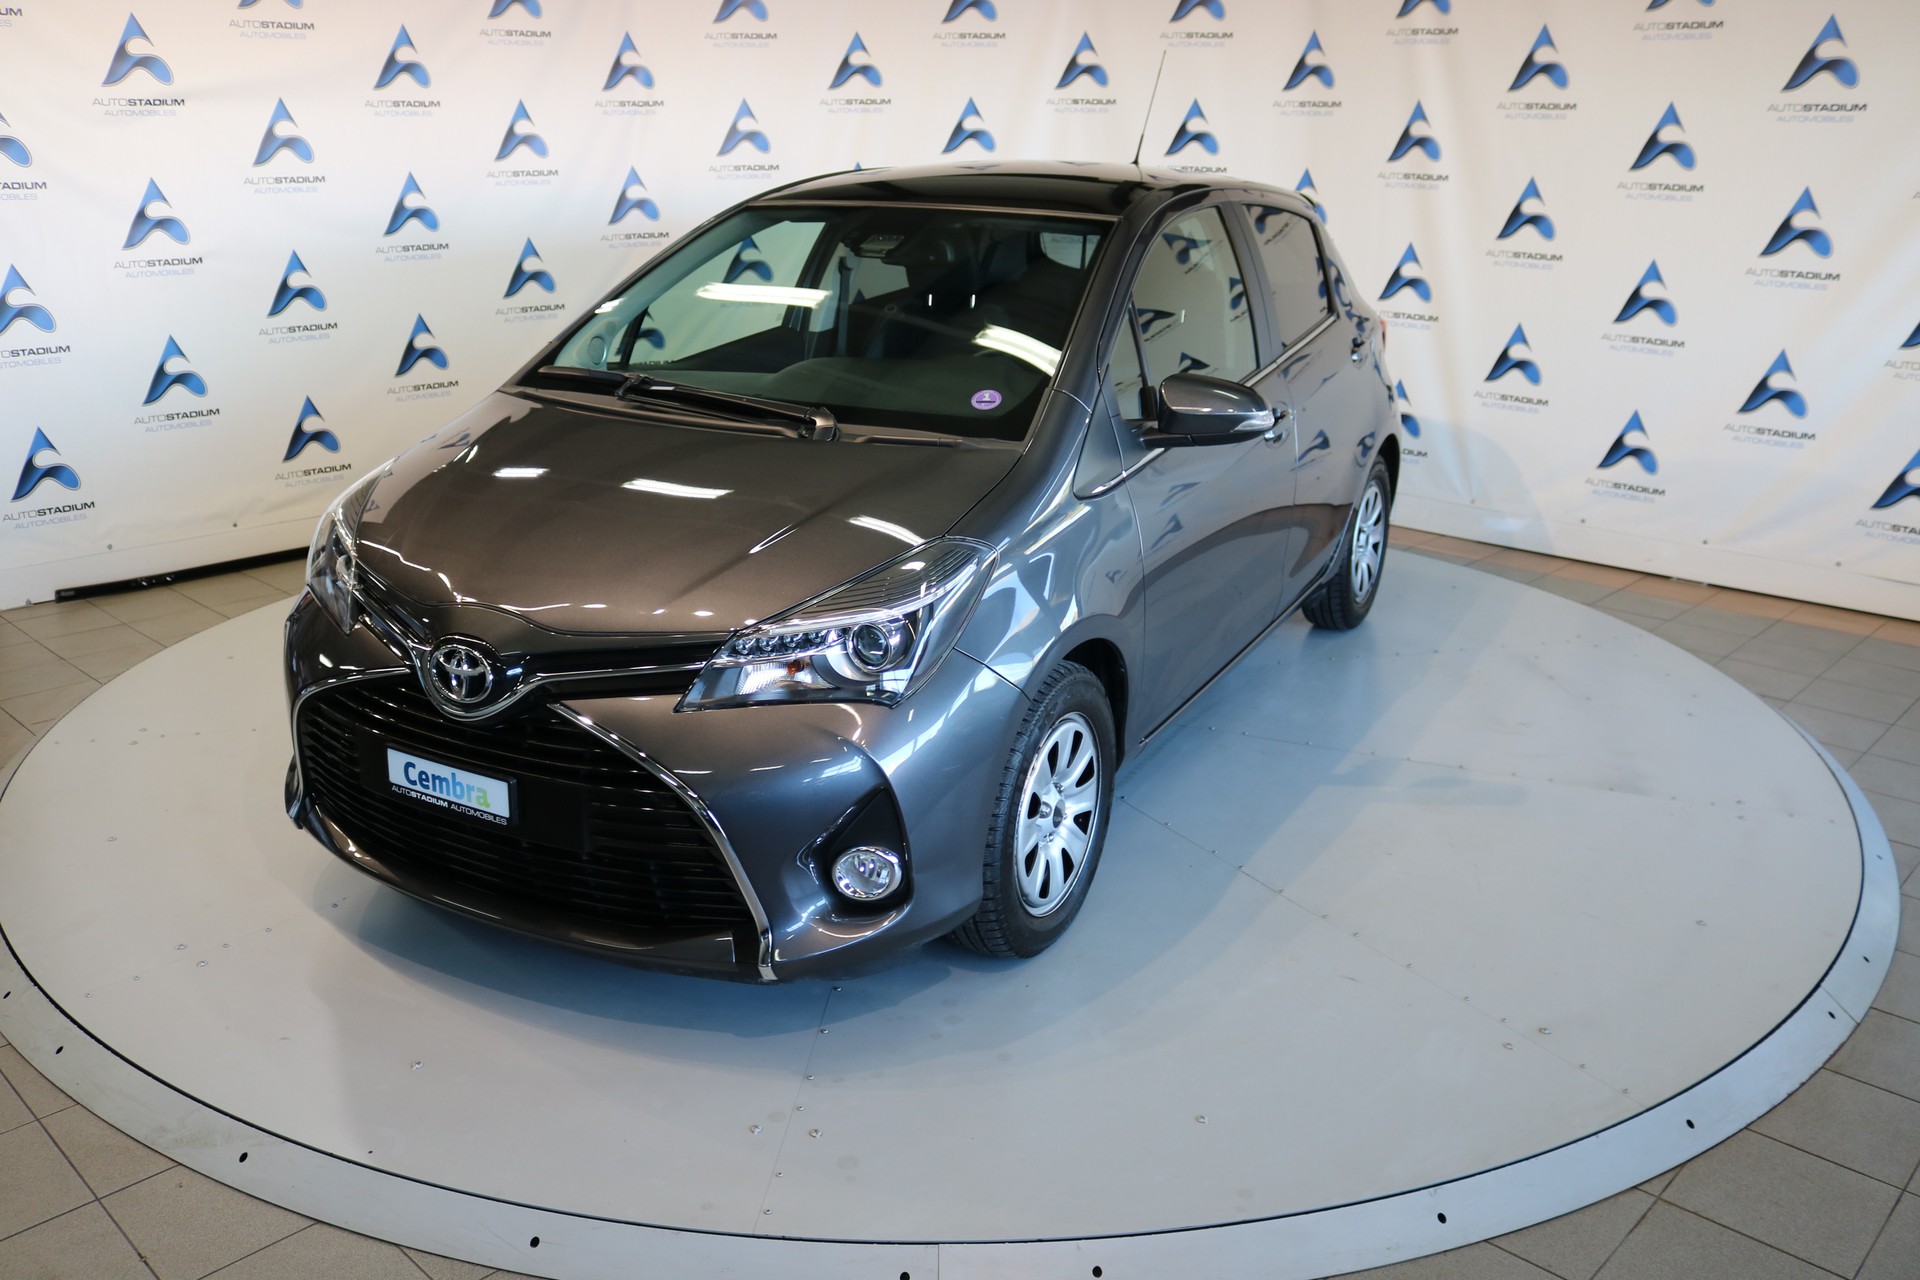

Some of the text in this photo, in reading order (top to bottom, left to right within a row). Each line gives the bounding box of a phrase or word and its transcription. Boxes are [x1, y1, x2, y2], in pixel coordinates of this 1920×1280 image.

[229, 19, 315, 30] AUTOSTADIUM
[1633, 20, 1724, 31] AUTOSTADIUM
[480, 28, 551, 38] AUTOSTADIUM
[704, 32, 778, 40] AUTOSTADIUM
[933, 32, 1006, 40] AUTOSTADIUM
[1386, 28, 1459, 36] AUTOSTADIUM
[92, 97, 185, 107] AUTOSTADIUM
[364, 100, 441, 108] AUTOSTADIUM
[819, 97, 892, 106] AUTOSTADIUM
[1273, 100, 1342, 108] AUTOSTADIUM
[1497, 102, 1577, 111] AUTOSTADIUM
[1767, 103, 1867, 113] AUTOSTADIUM
[708, 163, 780, 172] AUTOSTADIUM
[487, 169, 559, 178] AUTOSTADIUM
[1377, 172, 1449, 181] AUTOSTADIUM
[243, 175, 326, 185] AUTOSTADIUM
[1617, 182, 1704, 192] AUTOSTADIUM
[600, 231, 670, 242] AUTOSTADIUM
[375, 243, 449, 254] AUTOSTADIUM
[1486, 249, 1563, 263] AUTOSTADIUM
[114, 256, 203, 269] AUTOSTADIUM
[1745, 267, 1840, 281] AUTOSTADIUM
[495, 303, 565, 315] AUTOSTADIUM
[258, 322, 338, 336] AUTOSTADIUM
[1602, 332, 1685, 348] AUTOSTADIUM
[386, 380, 459, 395] AUTOSTADIUM
[1473, 390, 1549, 407] AUTOSTADIUM
[134, 408, 220, 425] AUTOSTADIUM
[1724, 422, 1816, 441] AUTOSTADIUM
[275, 463, 352, 481] AUTOSTADIUM
[1585, 477, 1665, 497] AUTOSTADIUM
[2, 501, 95, 523] AUTOSTADIUM
[404, 761, 490, 808] Cembra
[392, 785, 507, 826] AUTOSTADIUM AUTOMOBILES
